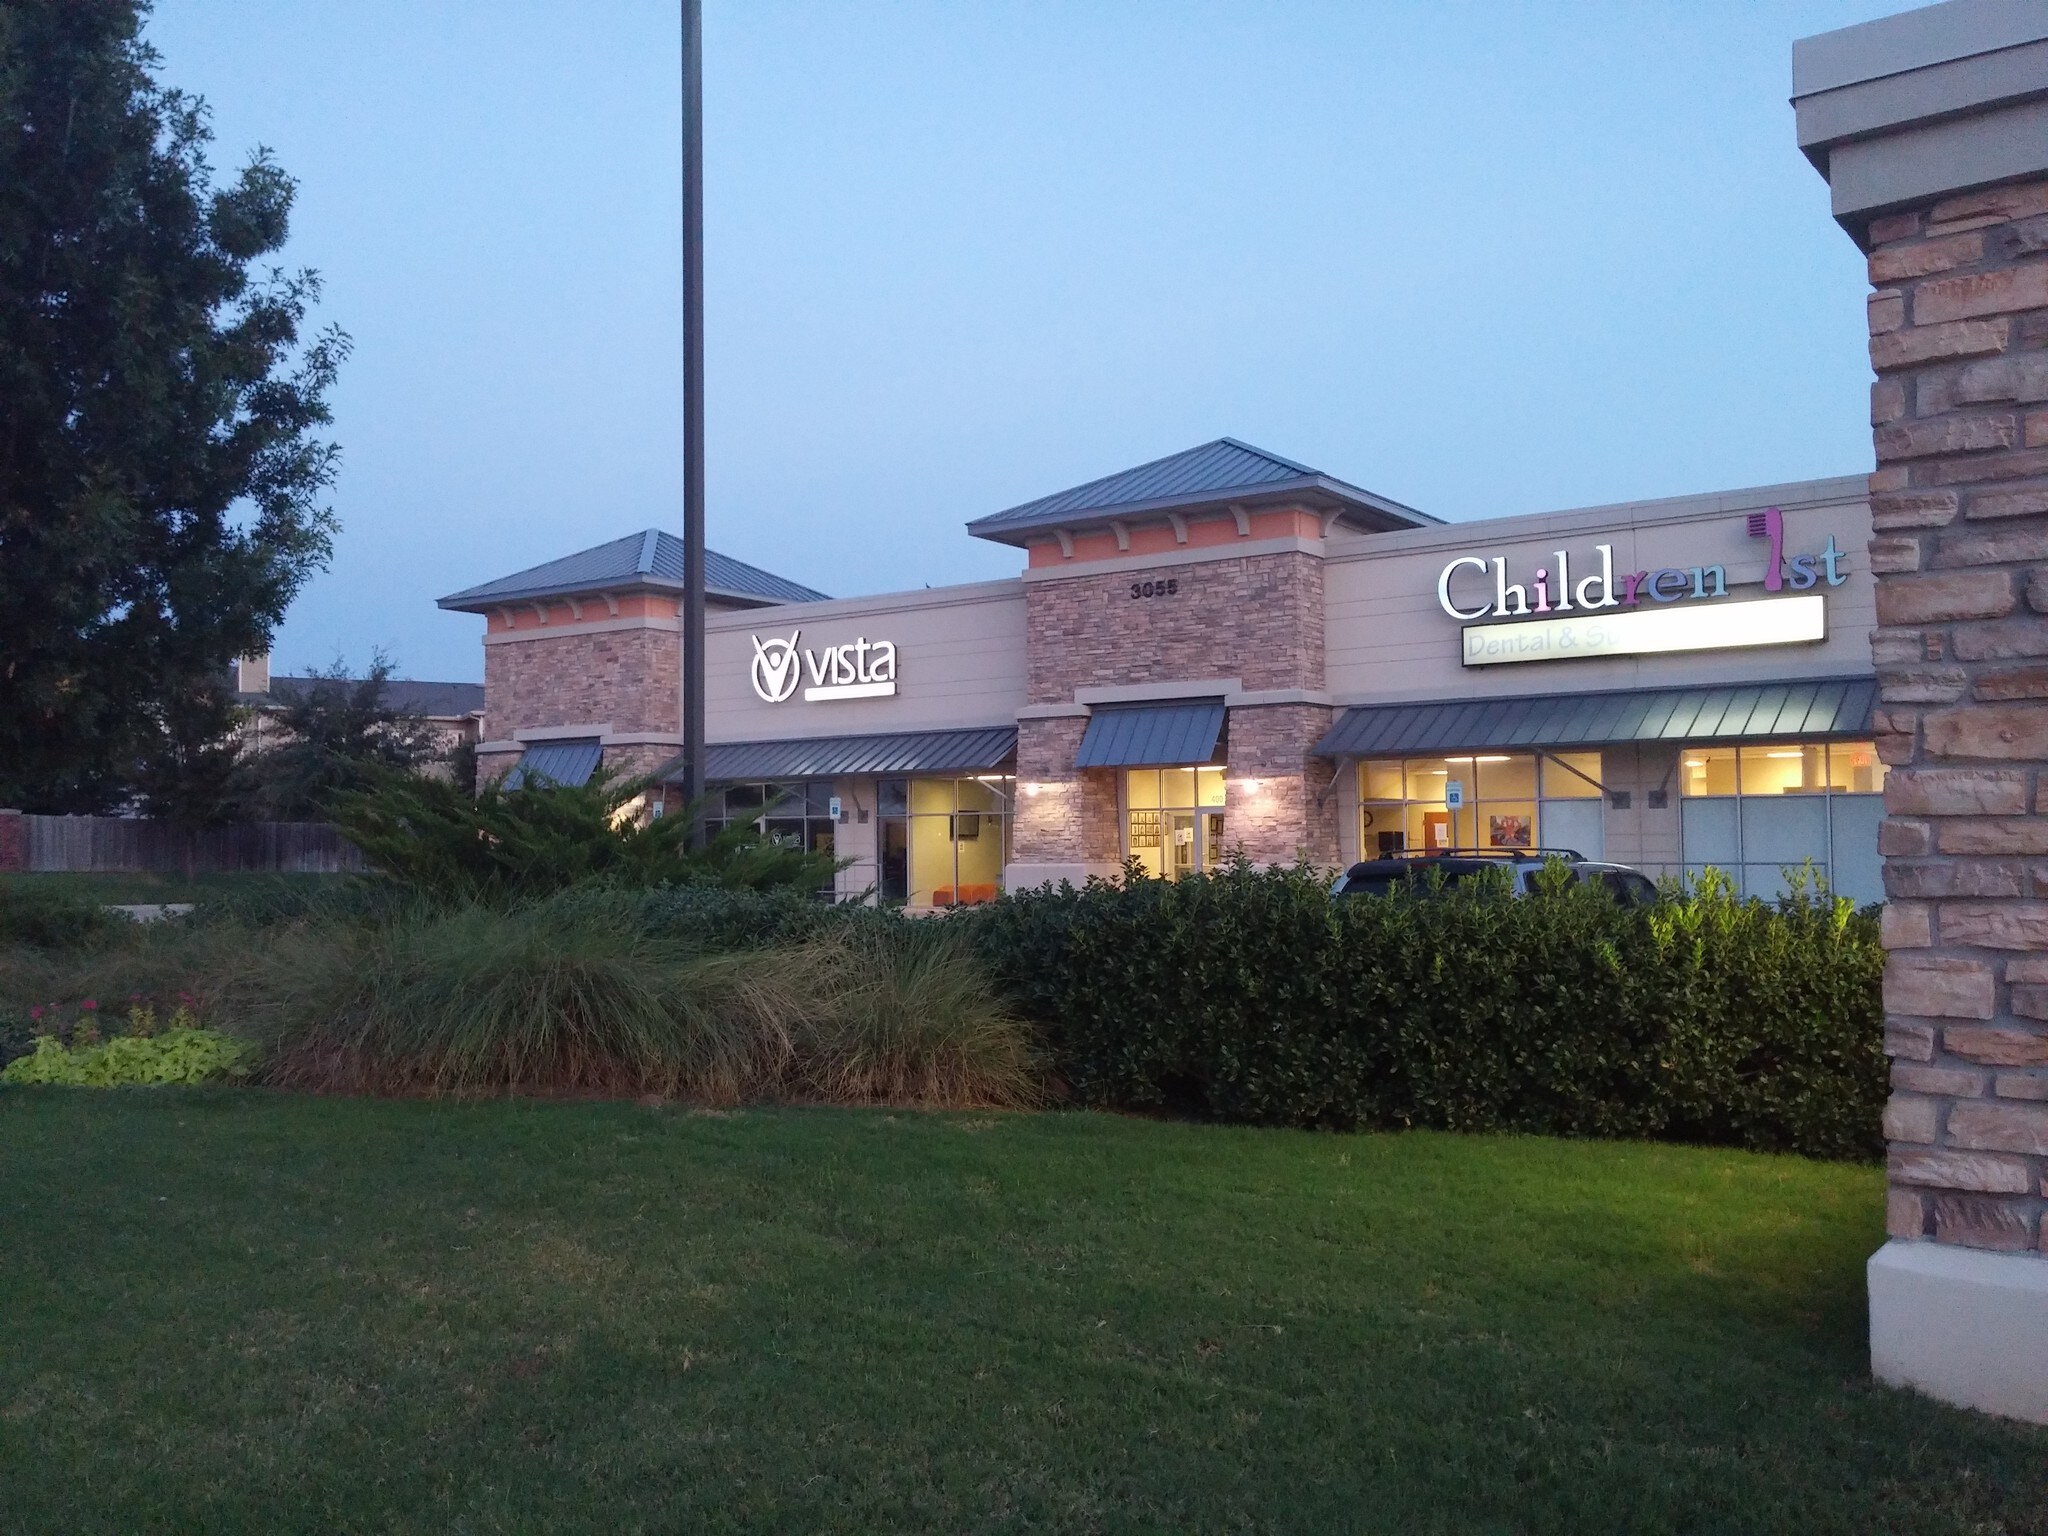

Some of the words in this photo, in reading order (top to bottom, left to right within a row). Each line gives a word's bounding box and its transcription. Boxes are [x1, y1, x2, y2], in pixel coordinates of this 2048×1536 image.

[1130, 579, 1178, 599] 3055
[1437, 544, 1730, 620] Children
[804, 636, 897, 686] vista
[1467, 628, 1551, 656] Dental
[1558, 626, 1578, 648] &
